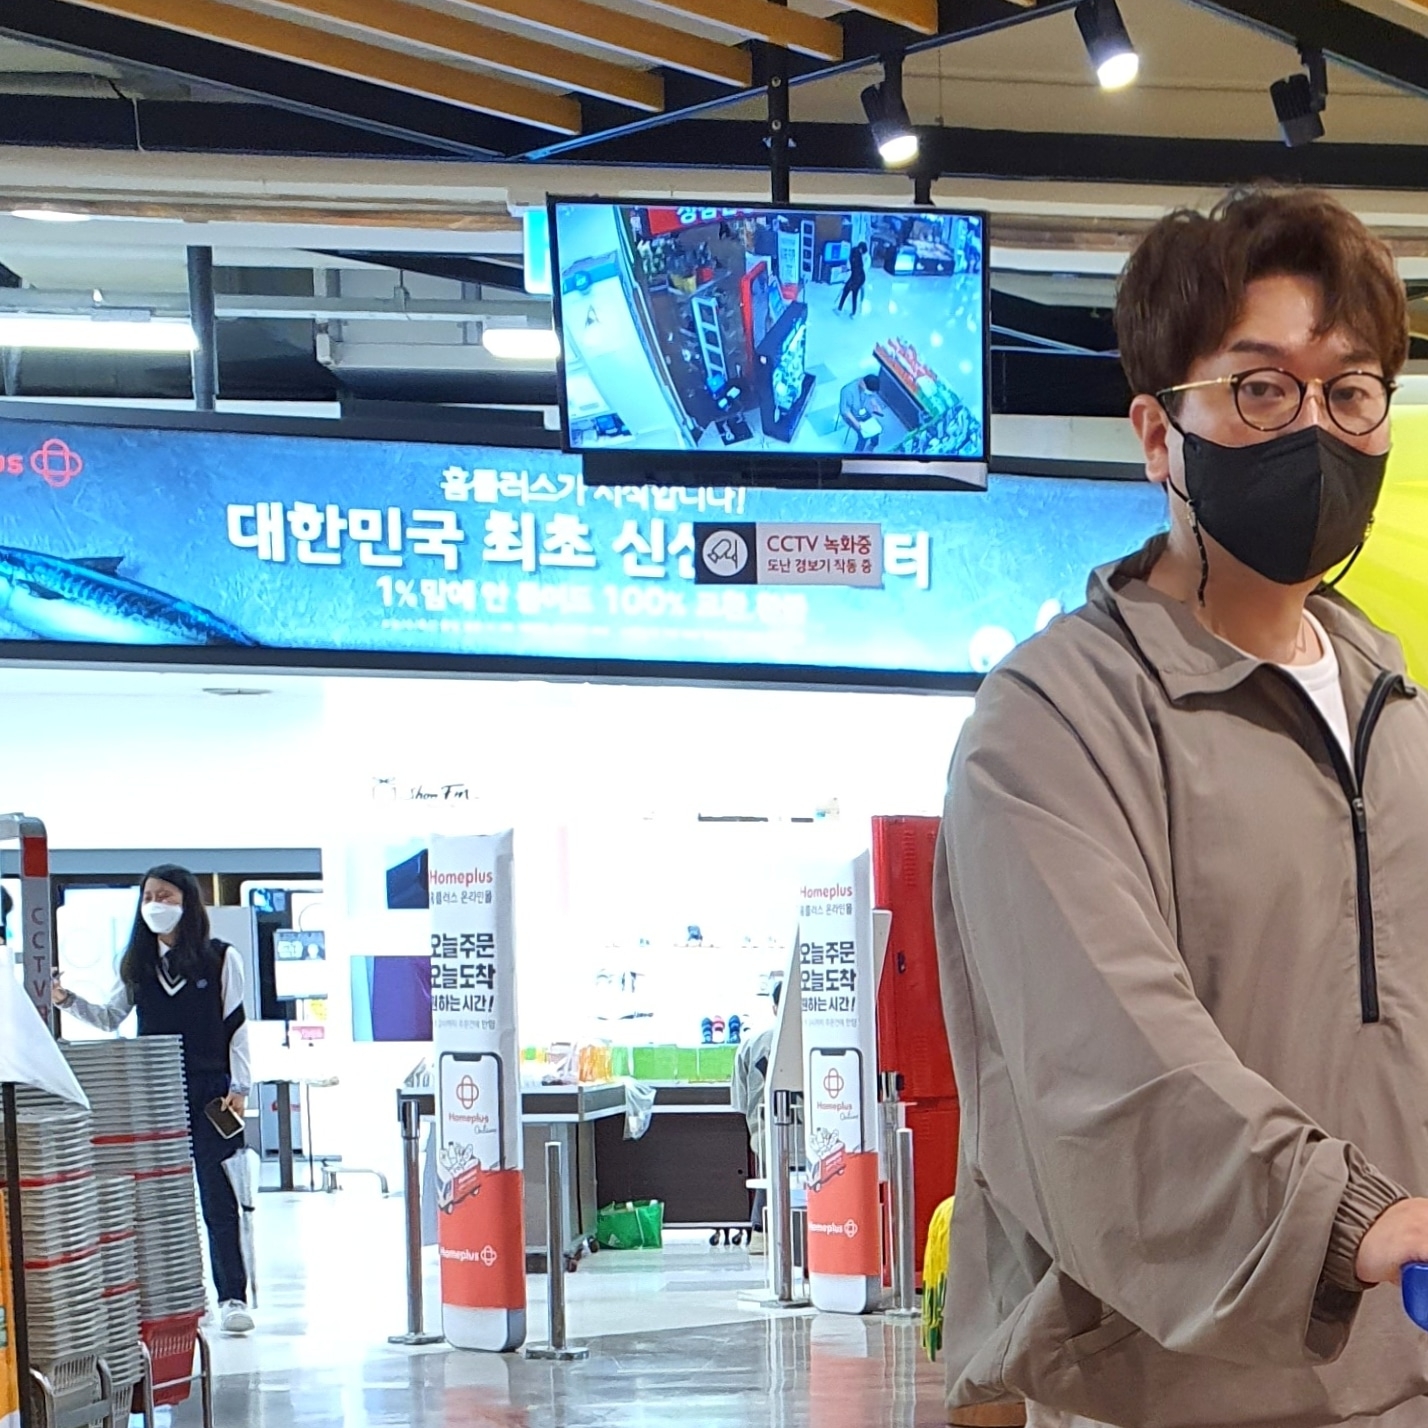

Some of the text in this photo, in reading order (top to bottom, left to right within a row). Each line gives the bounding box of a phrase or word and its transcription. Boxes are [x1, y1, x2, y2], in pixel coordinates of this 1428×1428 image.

[441, 466, 585, 506] 홈플러스가
[226, 501, 464, 570] 대한민국
[483, 509, 596, 572] 최초
[767, 533, 871, 555] CCTV 녹화중
[767, 559, 872, 575] 도난 경보기 작동 중
[376, 576, 418, 608] 1%
[603, 586, 686, 617] 100%
[429, 867, 493, 887] Homeplus
[800, 883, 853, 900] Homeplus
[463, 994, 494, 1013] 시간!
[829, 996, 856, 1012] 시간!
[816, 1100, 853, 1112] Homeplus
[448, 1112, 489, 1125] Homeplus
